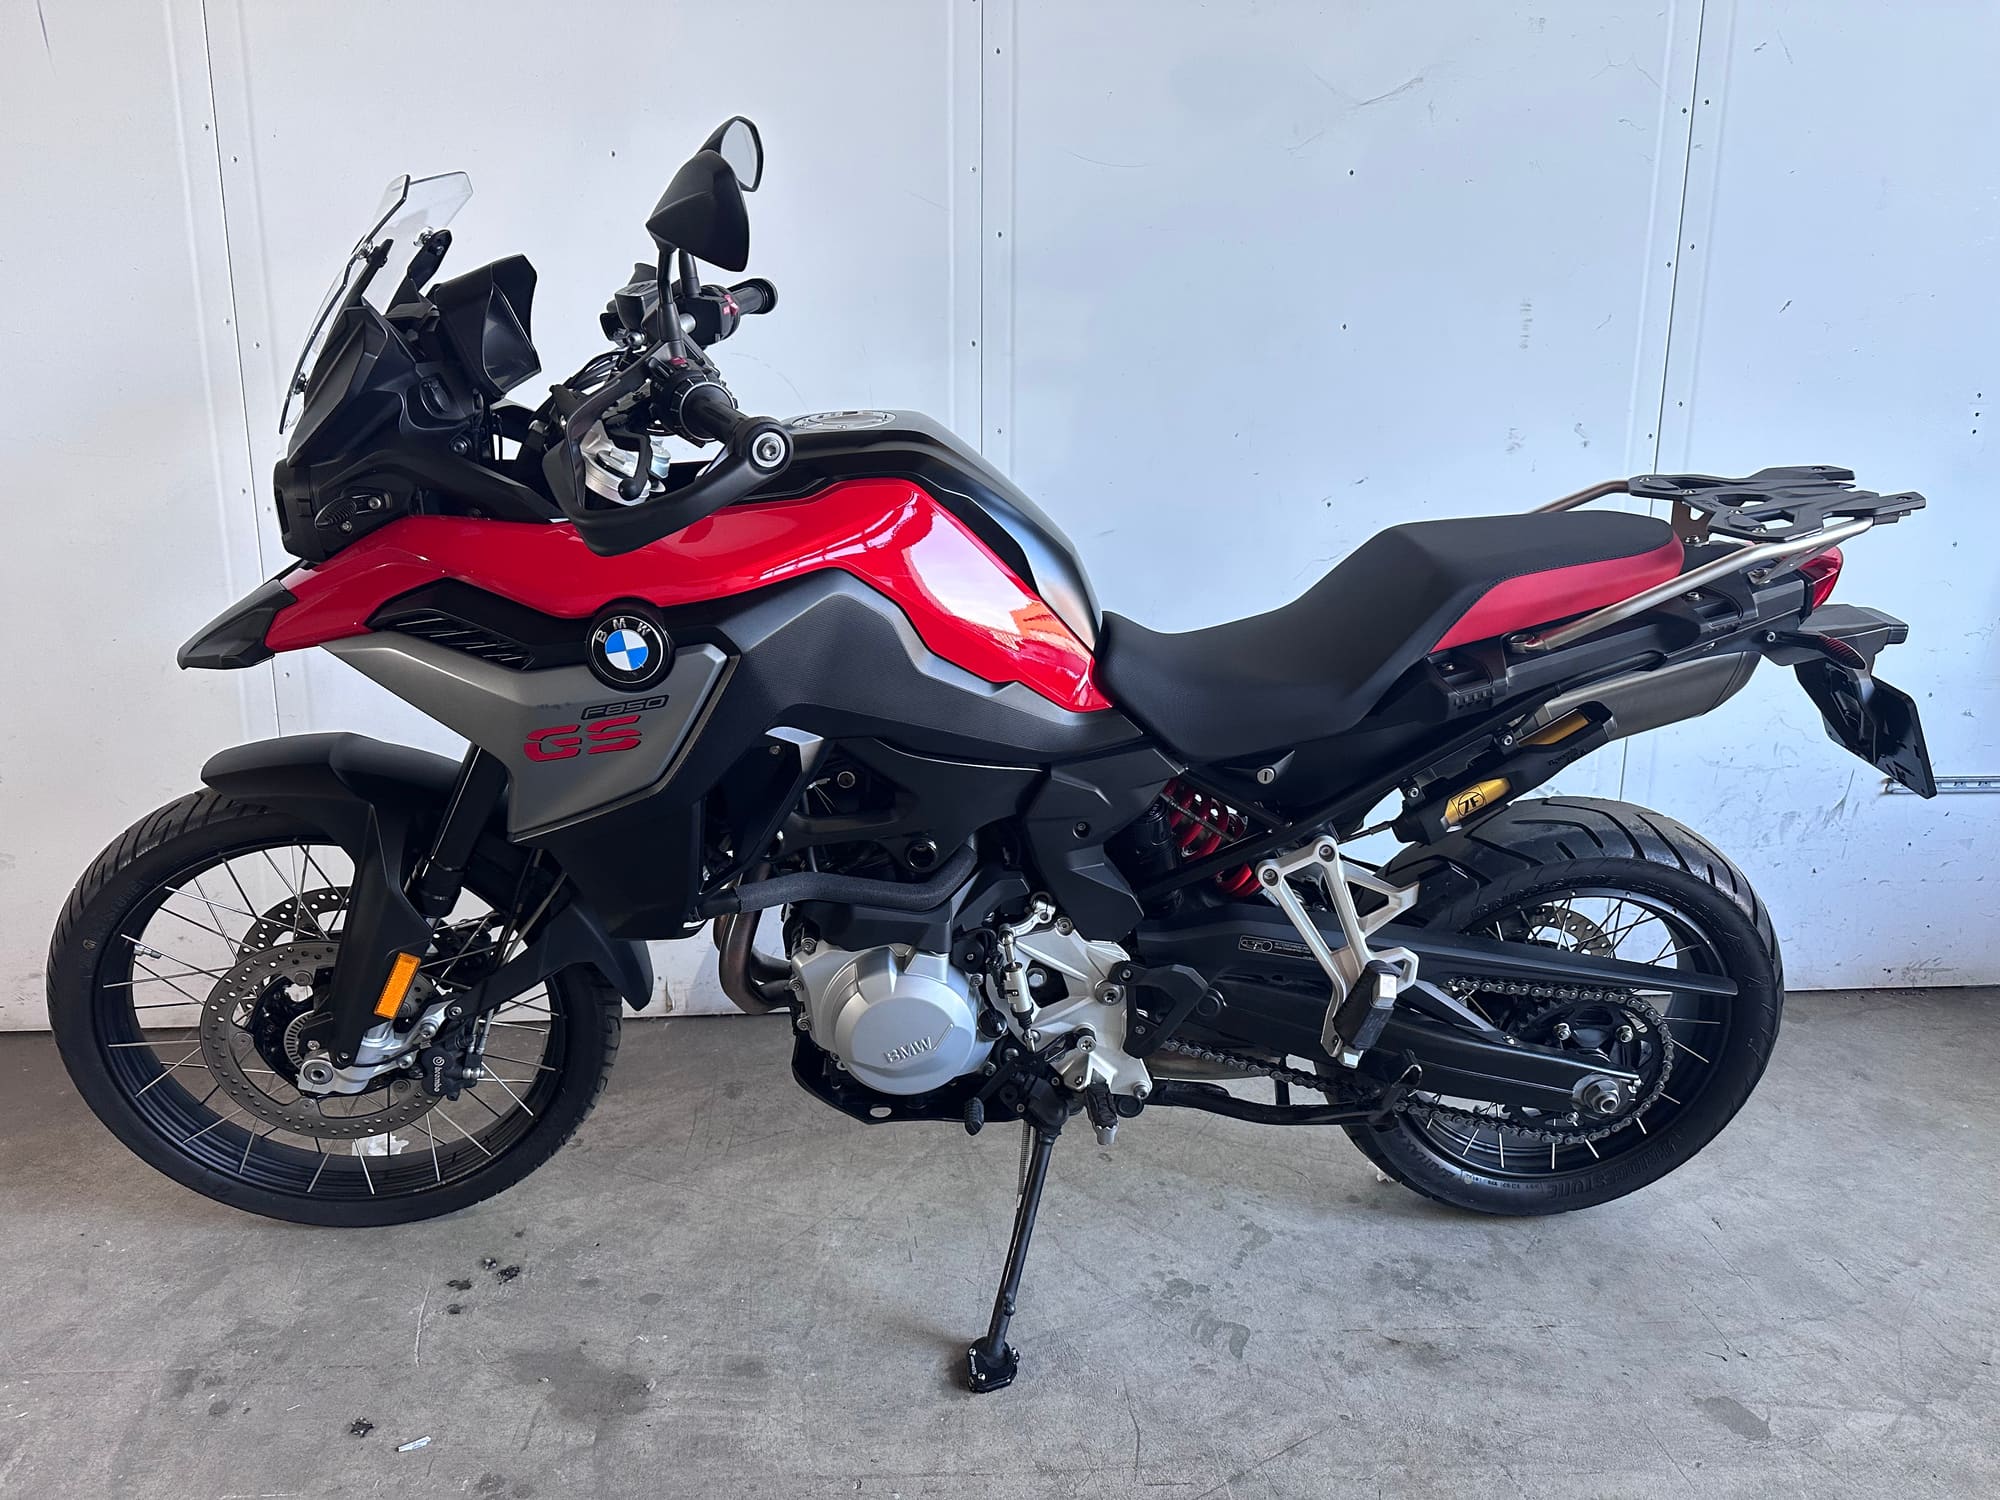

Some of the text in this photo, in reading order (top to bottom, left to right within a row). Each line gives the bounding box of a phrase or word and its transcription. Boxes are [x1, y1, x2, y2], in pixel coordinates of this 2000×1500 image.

[596, 617, 651, 643] BMW
[583, 696, 666, 719] F850
[523, 714, 642, 762] GS
[884, 1036, 933, 1064] BMW
[433, 1066, 443, 1092] brembo
